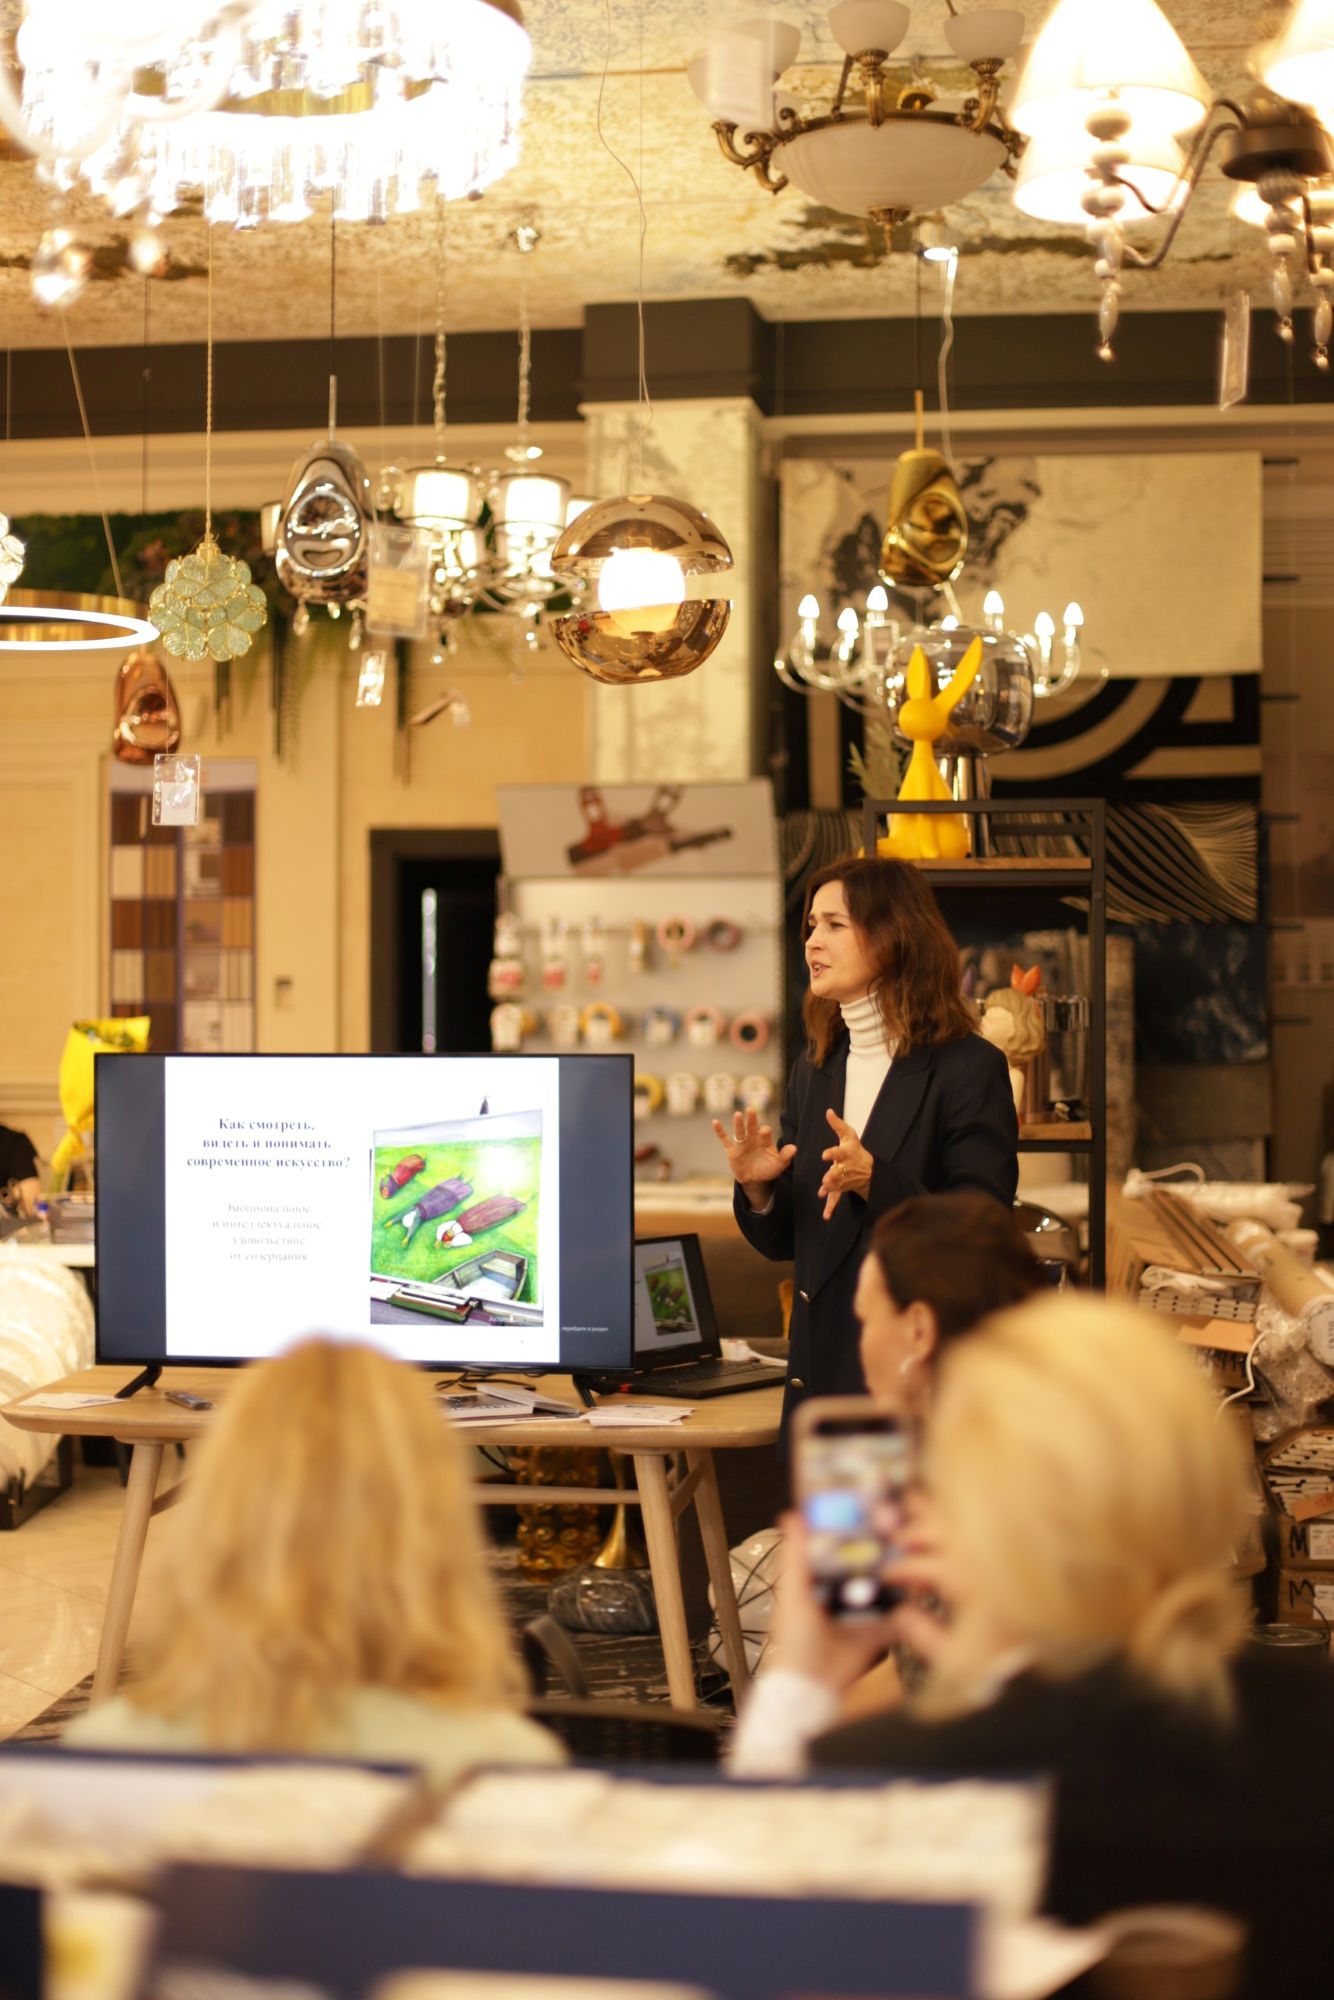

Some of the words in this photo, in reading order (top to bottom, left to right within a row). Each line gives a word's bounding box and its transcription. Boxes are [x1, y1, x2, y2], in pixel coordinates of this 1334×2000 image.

[219, 1118, 245, 1130] Как
[203, 1139, 249, 1149] видеть
[252, 1139, 260, 1149] и
[265, 1139, 331, 1149] понимать
[187, 1158, 272, 1170] современное
[276, 1157, 350, 1170] искусство?
